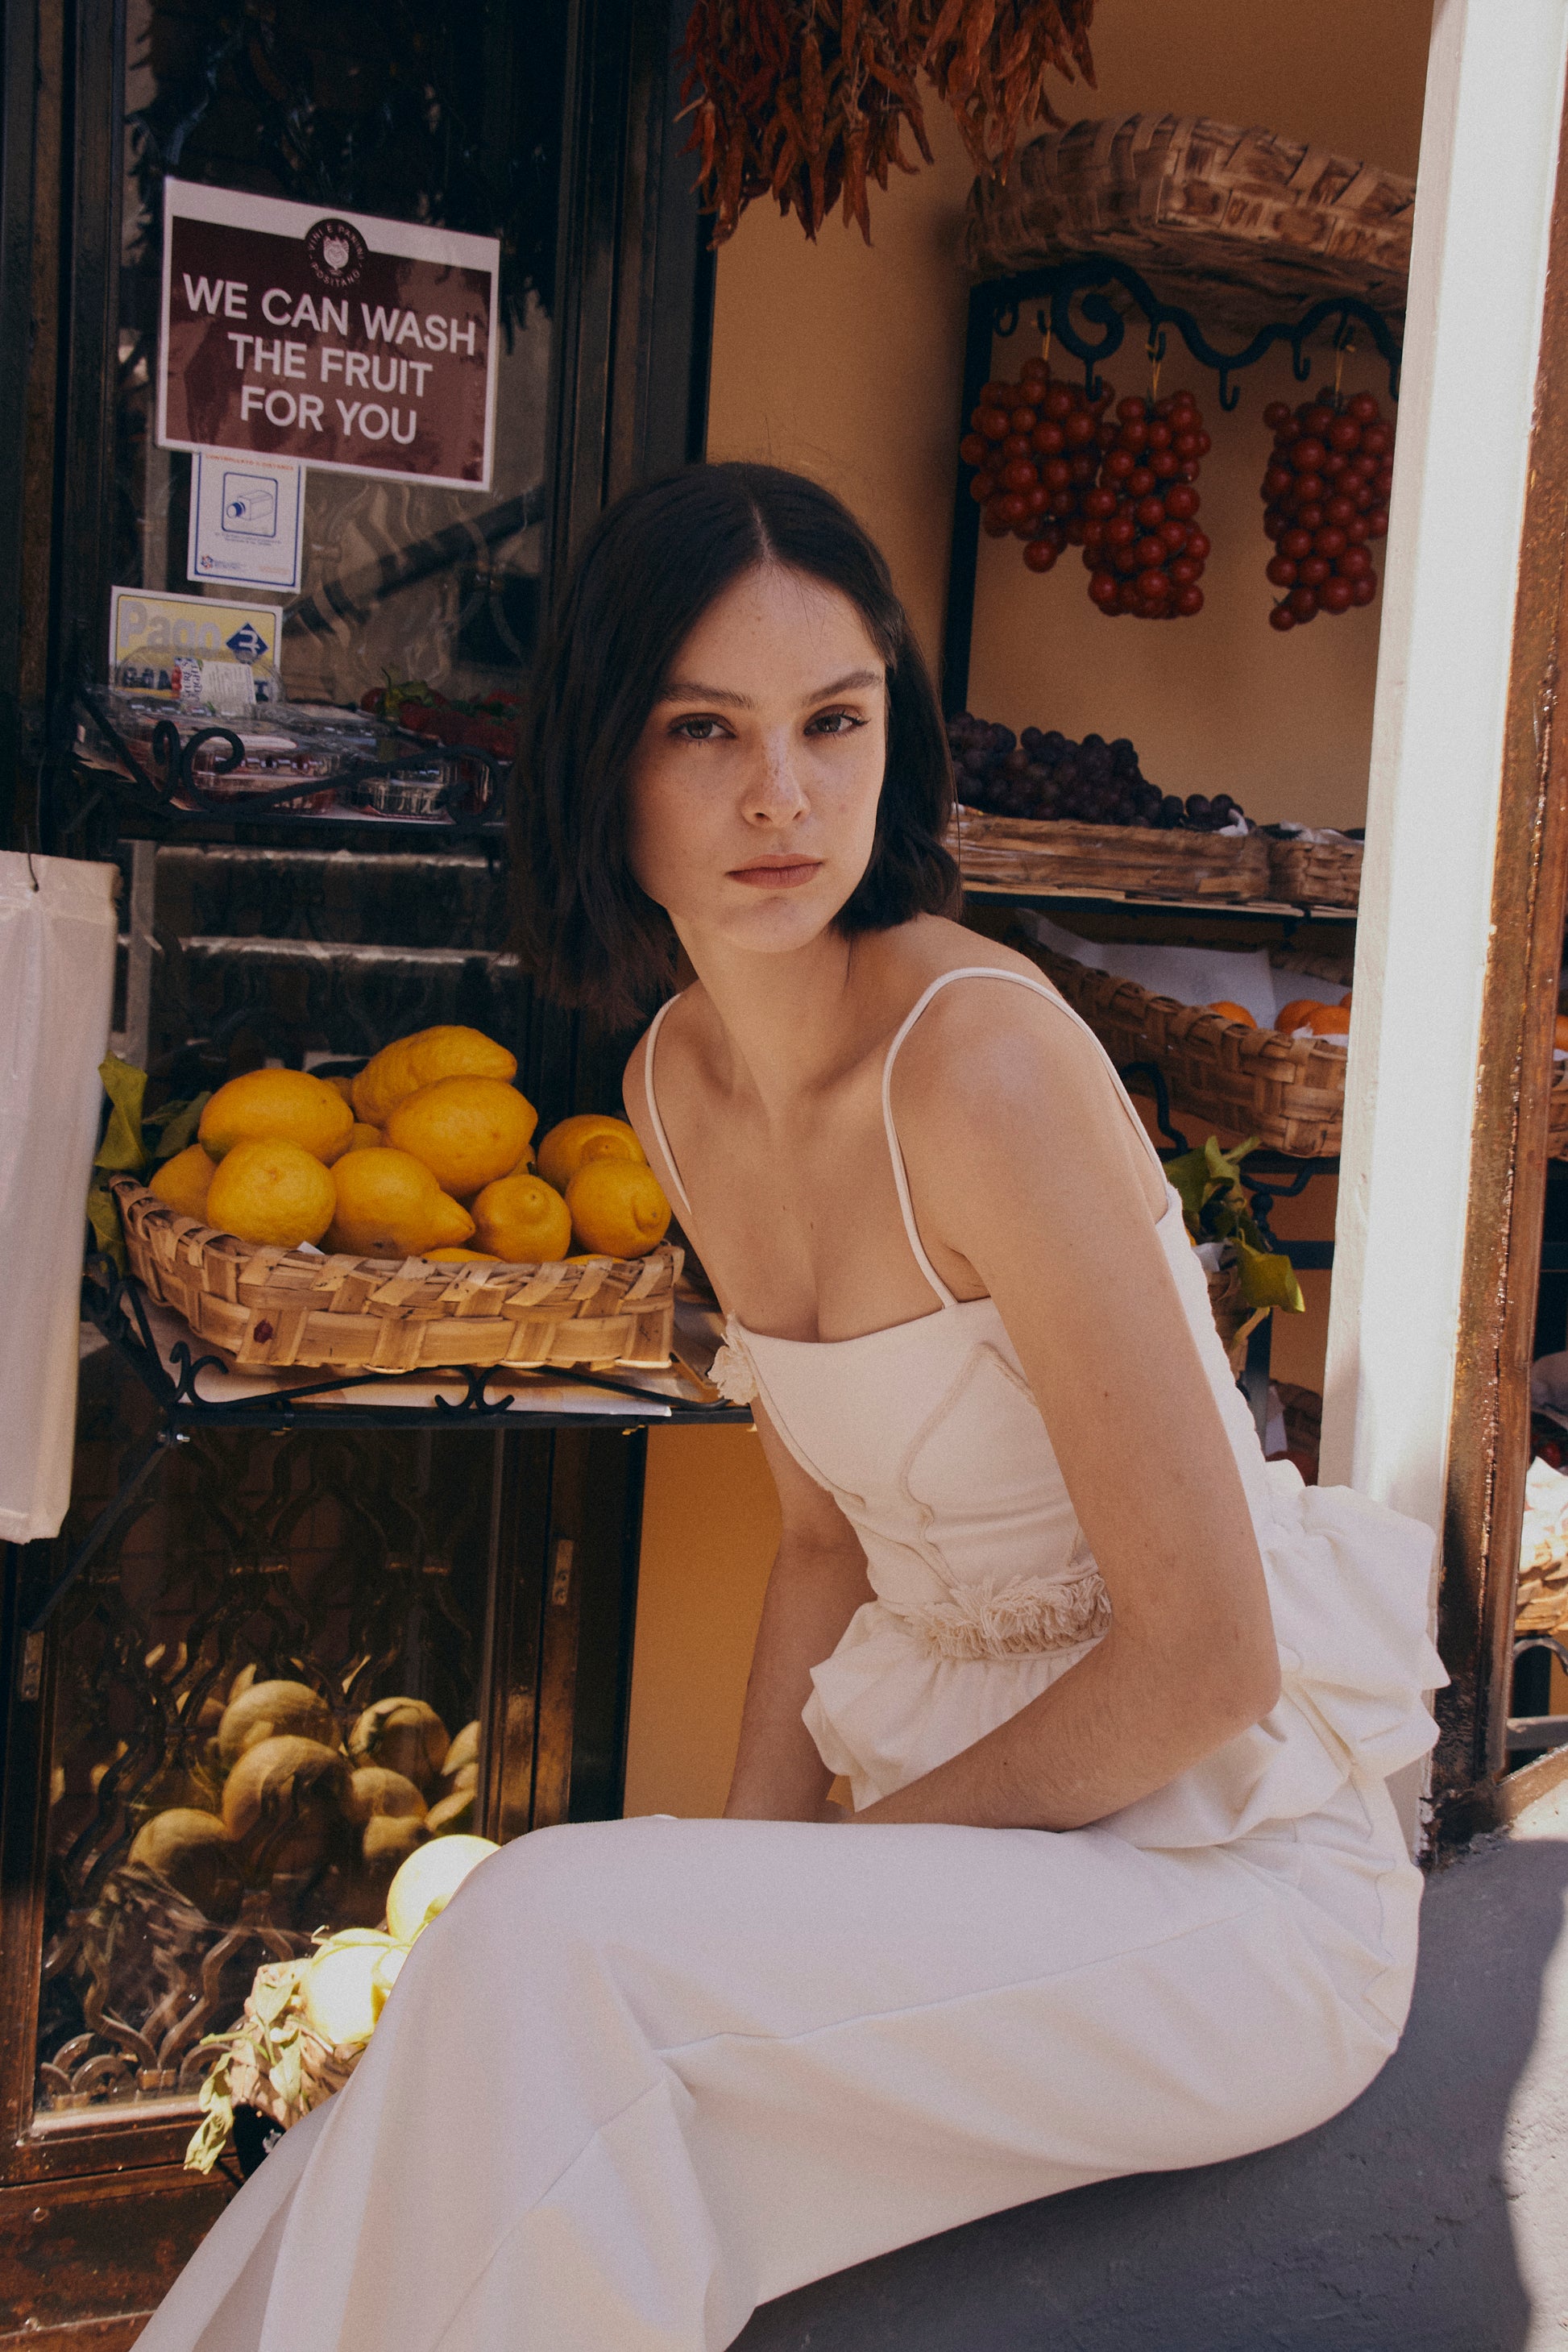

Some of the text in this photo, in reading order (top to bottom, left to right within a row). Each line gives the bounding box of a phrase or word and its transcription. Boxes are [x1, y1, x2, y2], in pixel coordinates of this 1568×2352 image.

[308, 229, 324, 251] VINI
[326, 223, 333, 234] E
[309, 261, 361, 288] POSITANO
[182, 272, 476, 356] WE CAN WASH
[227, 332, 433, 398] THE FRUIT
[240, 385, 417, 445] FOR YOU
[119, 599, 222, 659] Pago
